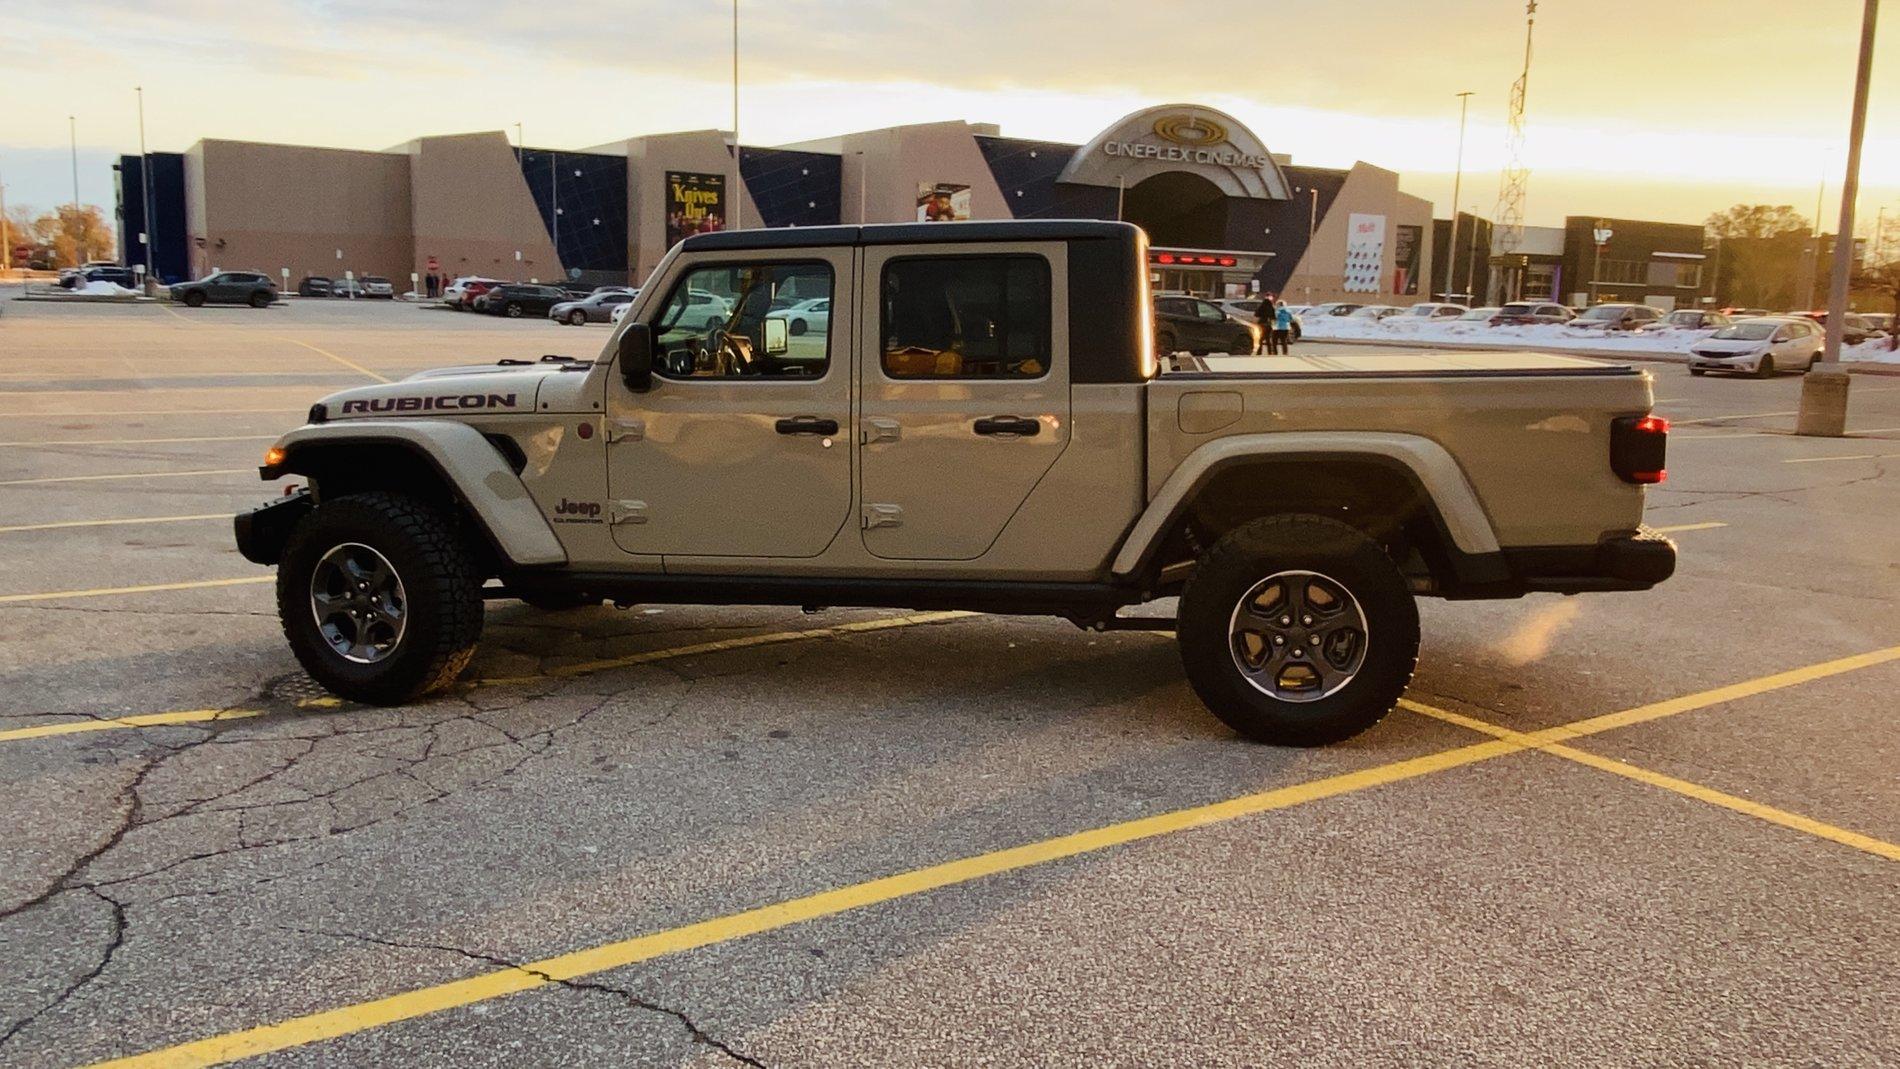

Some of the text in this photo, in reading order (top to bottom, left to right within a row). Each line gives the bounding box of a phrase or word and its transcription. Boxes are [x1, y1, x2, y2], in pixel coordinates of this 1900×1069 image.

[1104, 141, 1267, 169] CINEPLEX CINEMAS
[672, 183, 718, 204] Knives
[685, 203, 706, 219] Out
[342, 393, 516, 414] RUBICON
[555, 498, 601, 517] Jeep
